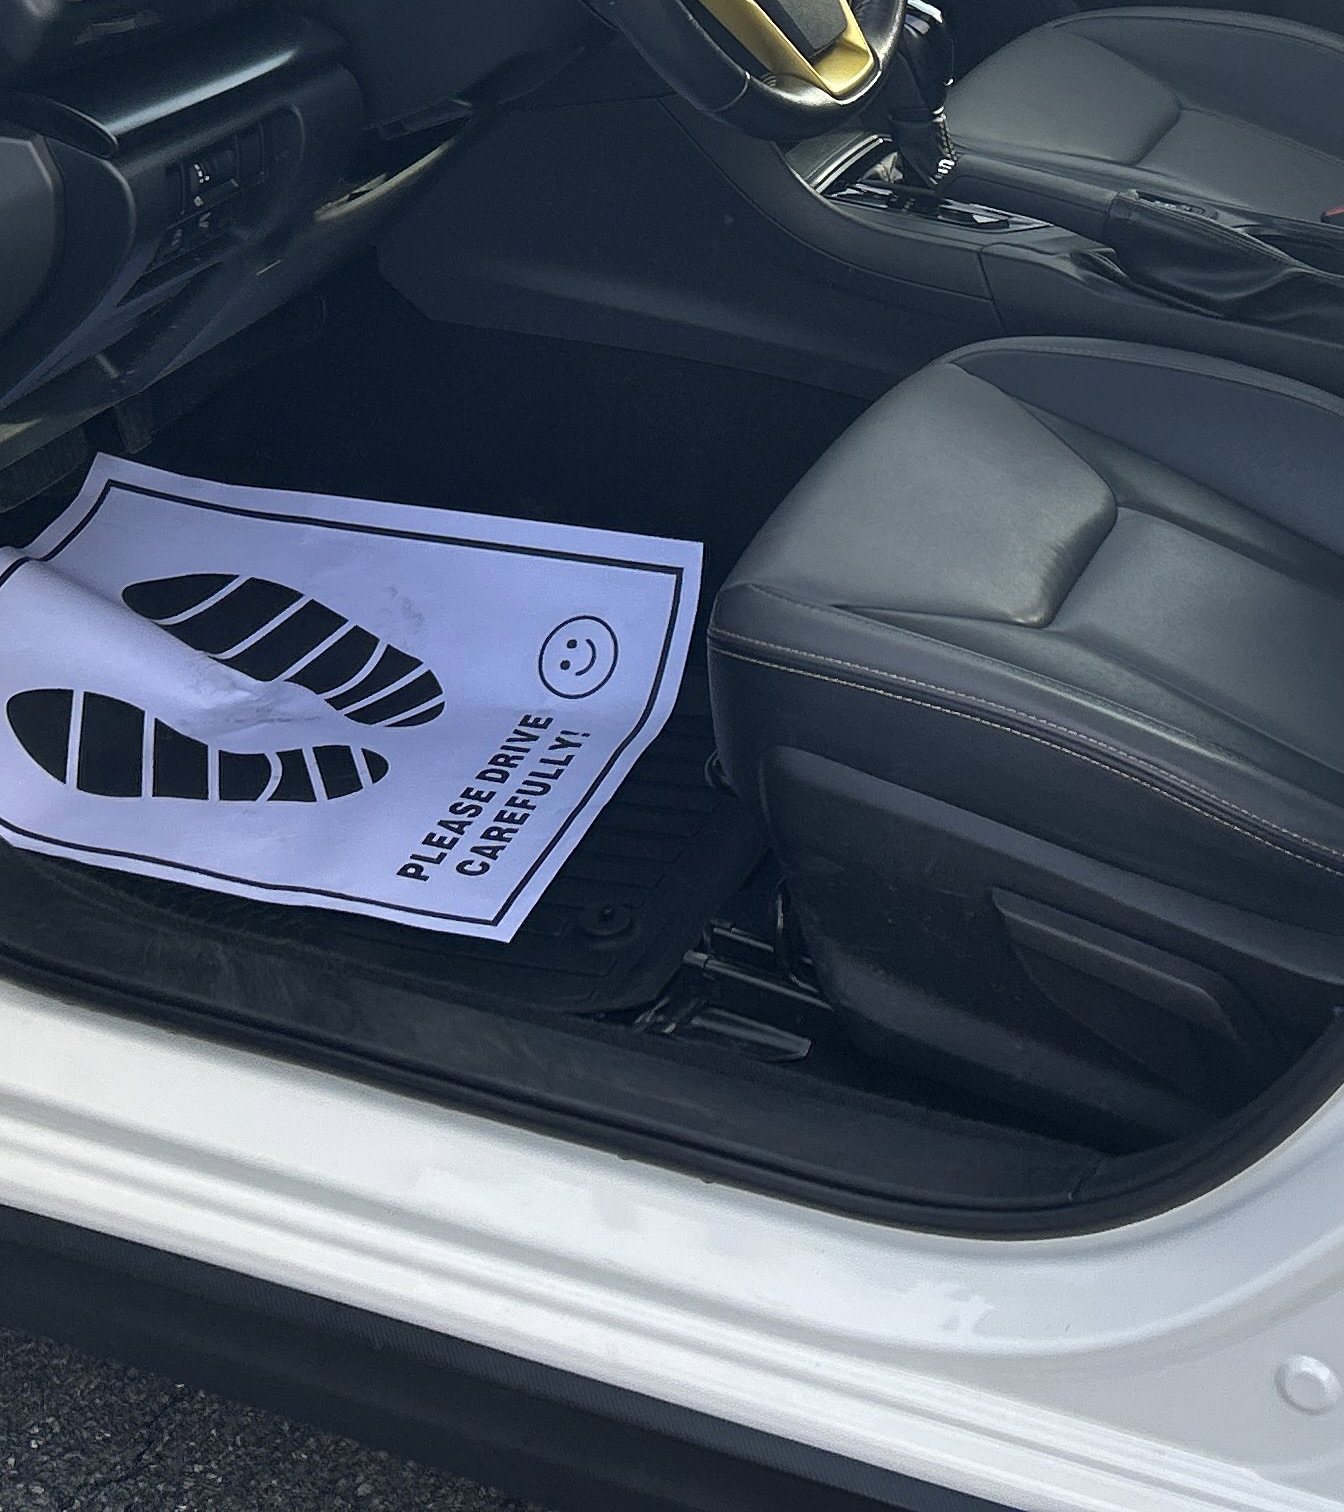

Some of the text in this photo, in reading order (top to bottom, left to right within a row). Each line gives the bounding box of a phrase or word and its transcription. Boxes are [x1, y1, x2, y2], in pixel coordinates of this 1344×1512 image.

[396, 714, 554, 882] PLEASE DRIVE
[455, 729, 591, 877] CAREFULLY!
